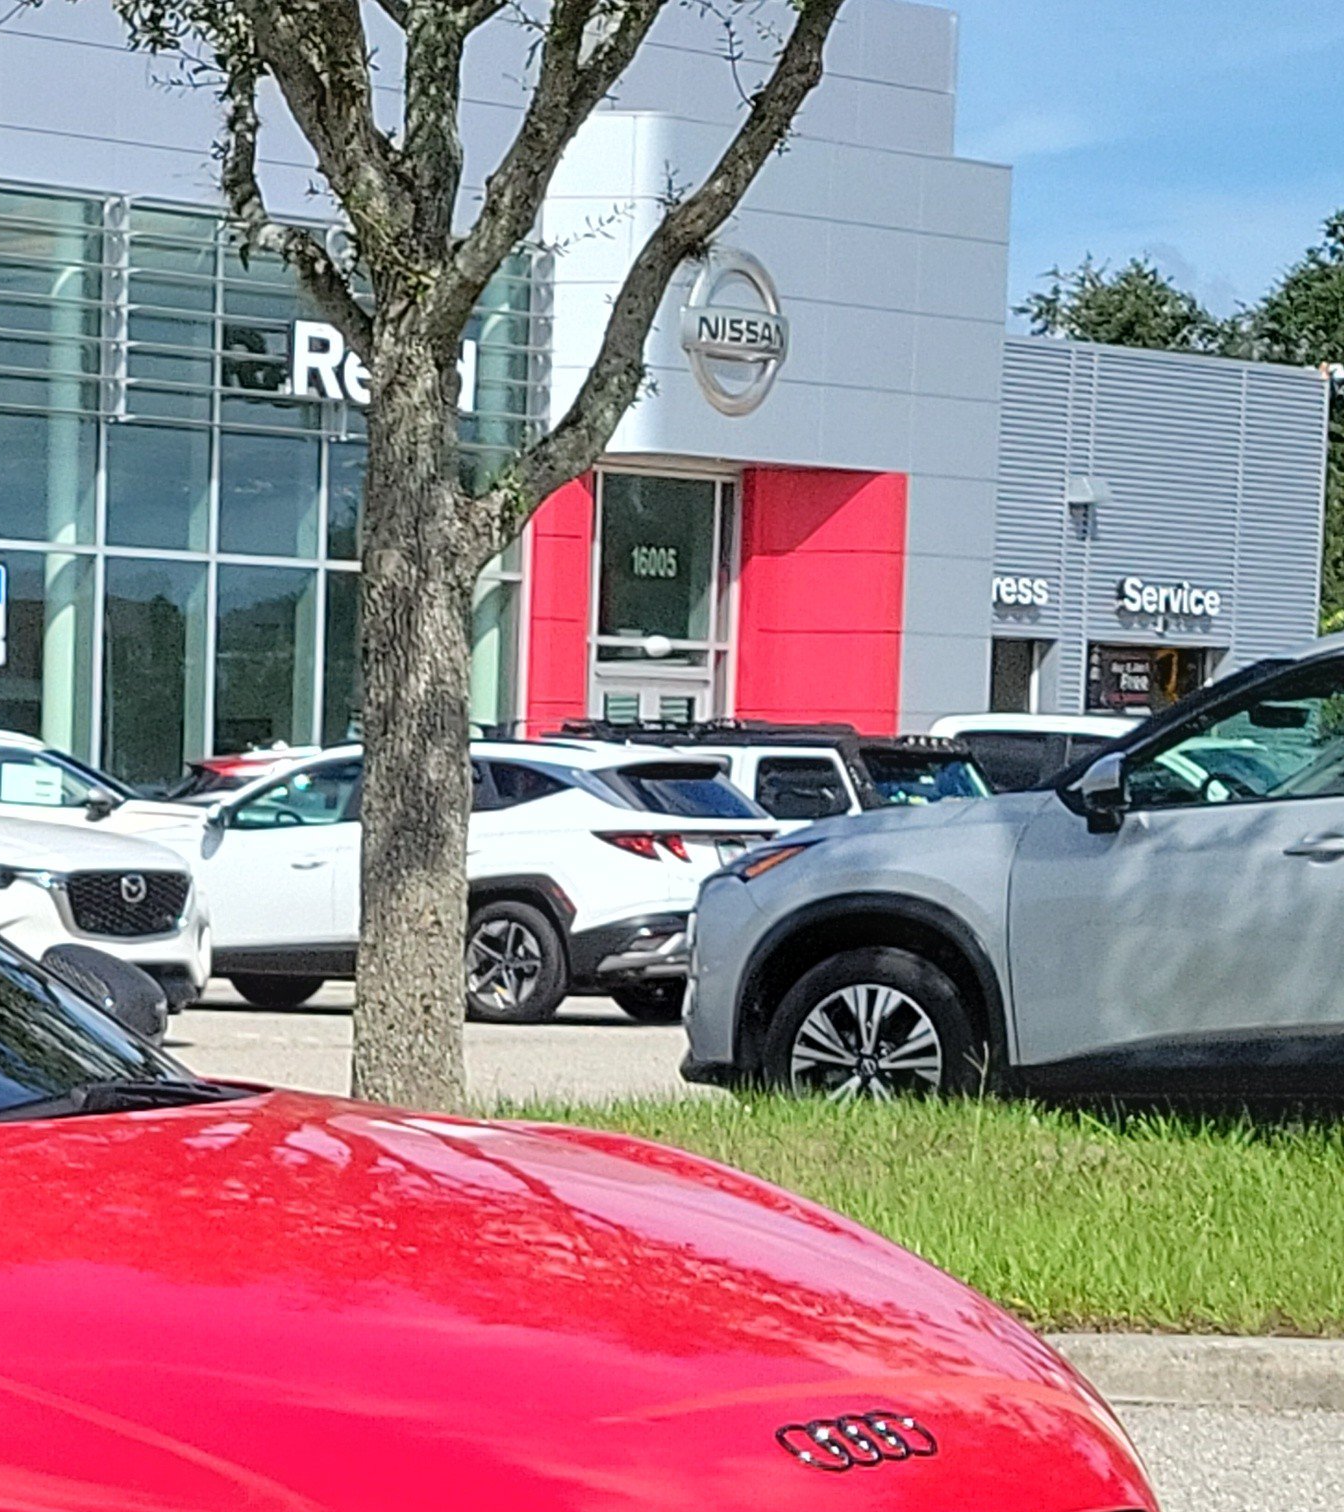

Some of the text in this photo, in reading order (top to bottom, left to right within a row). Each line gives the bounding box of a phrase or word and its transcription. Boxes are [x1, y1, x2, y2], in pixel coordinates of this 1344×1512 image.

[697, 316, 784, 348] NISSAN
[631, 545, 677, 577] 16005
[992, 576, 1221, 616] ress Service
